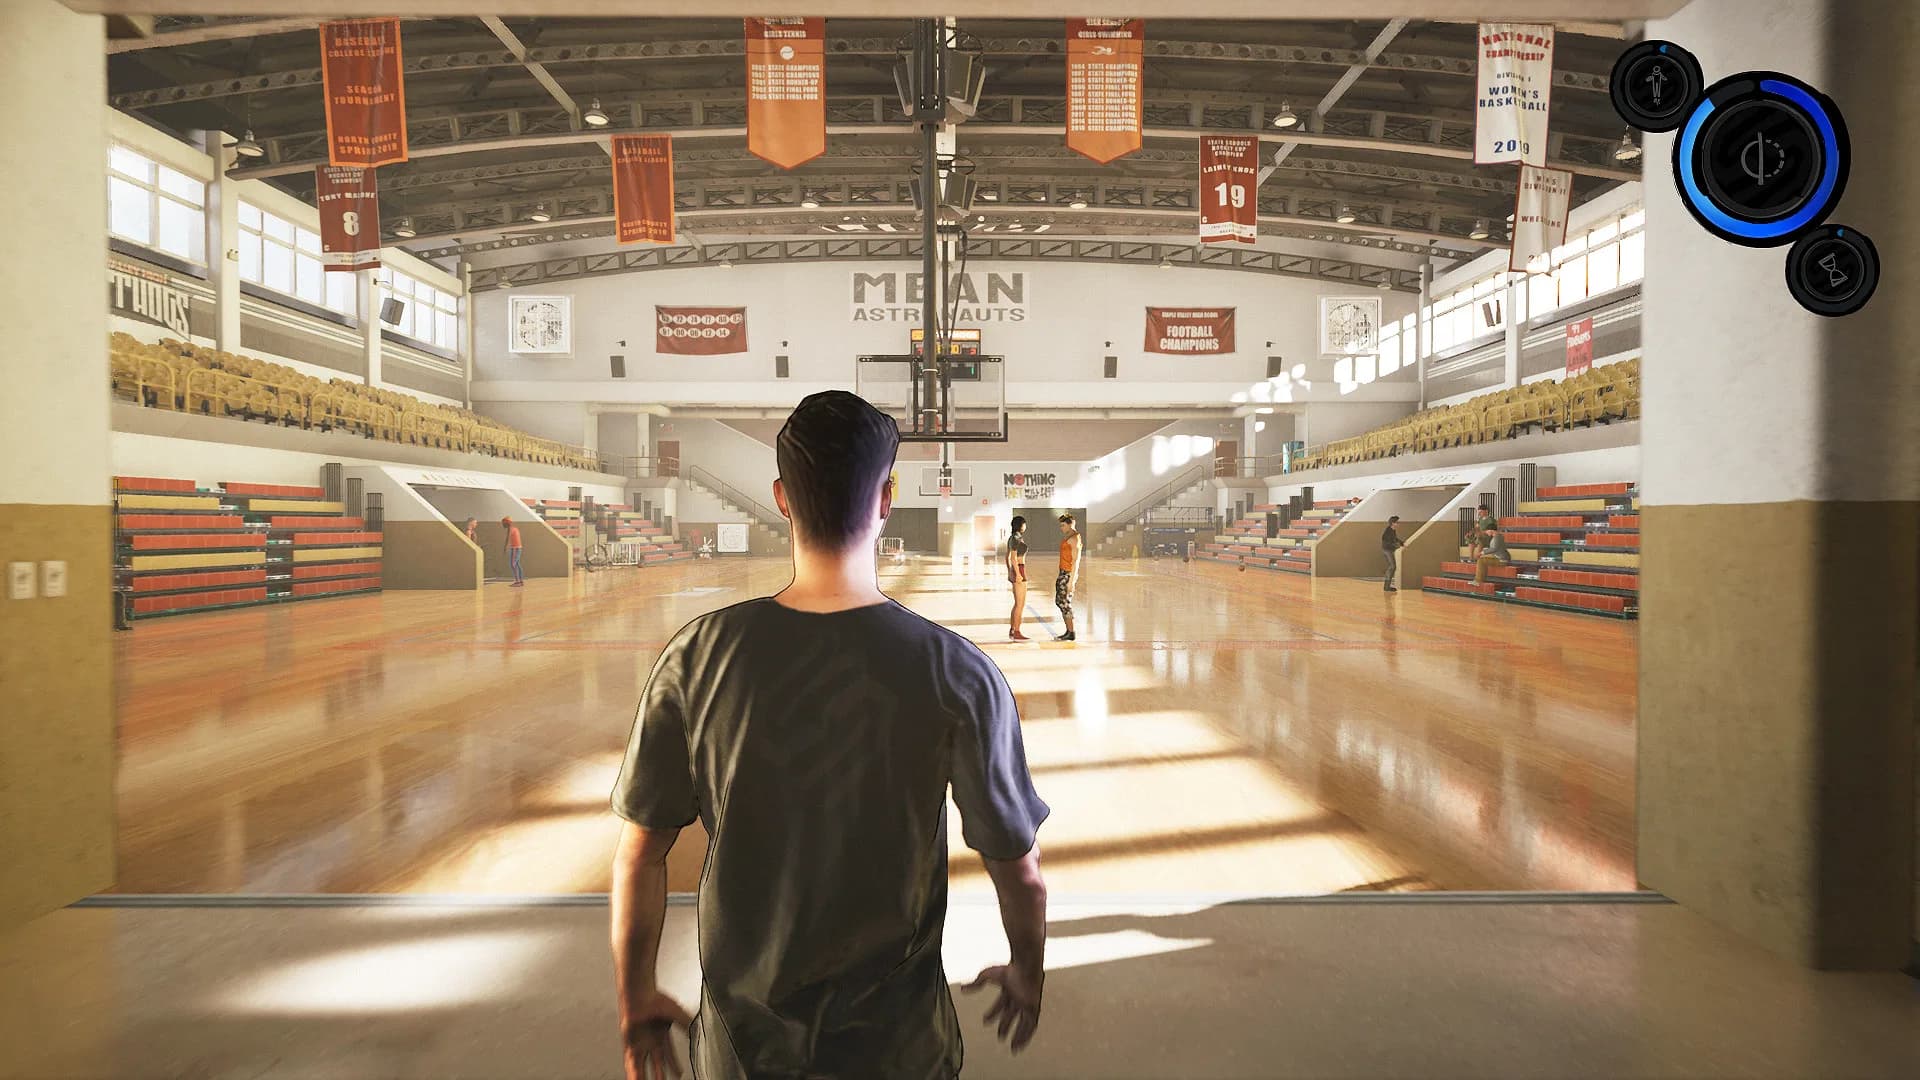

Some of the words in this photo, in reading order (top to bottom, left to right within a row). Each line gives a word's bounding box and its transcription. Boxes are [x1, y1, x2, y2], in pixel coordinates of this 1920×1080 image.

[1482, 31, 1551, 49] NATIONAL
[1489, 85, 1539, 99] WOMEN'S
[1479, 96, 1546, 111] BASKETBALL
[1494, 139, 1530, 155] 2019
[1214, 182, 1246, 208] 19
[342, 211, 360, 236] 8
[853, 272, 1024, 304] MEAN
[1166, 325, 1214, 337] FOOTBALL
[1160, 337, 1219, 350] CHAMPIONS
[1004, 473, 1056, 486] NOTHING
